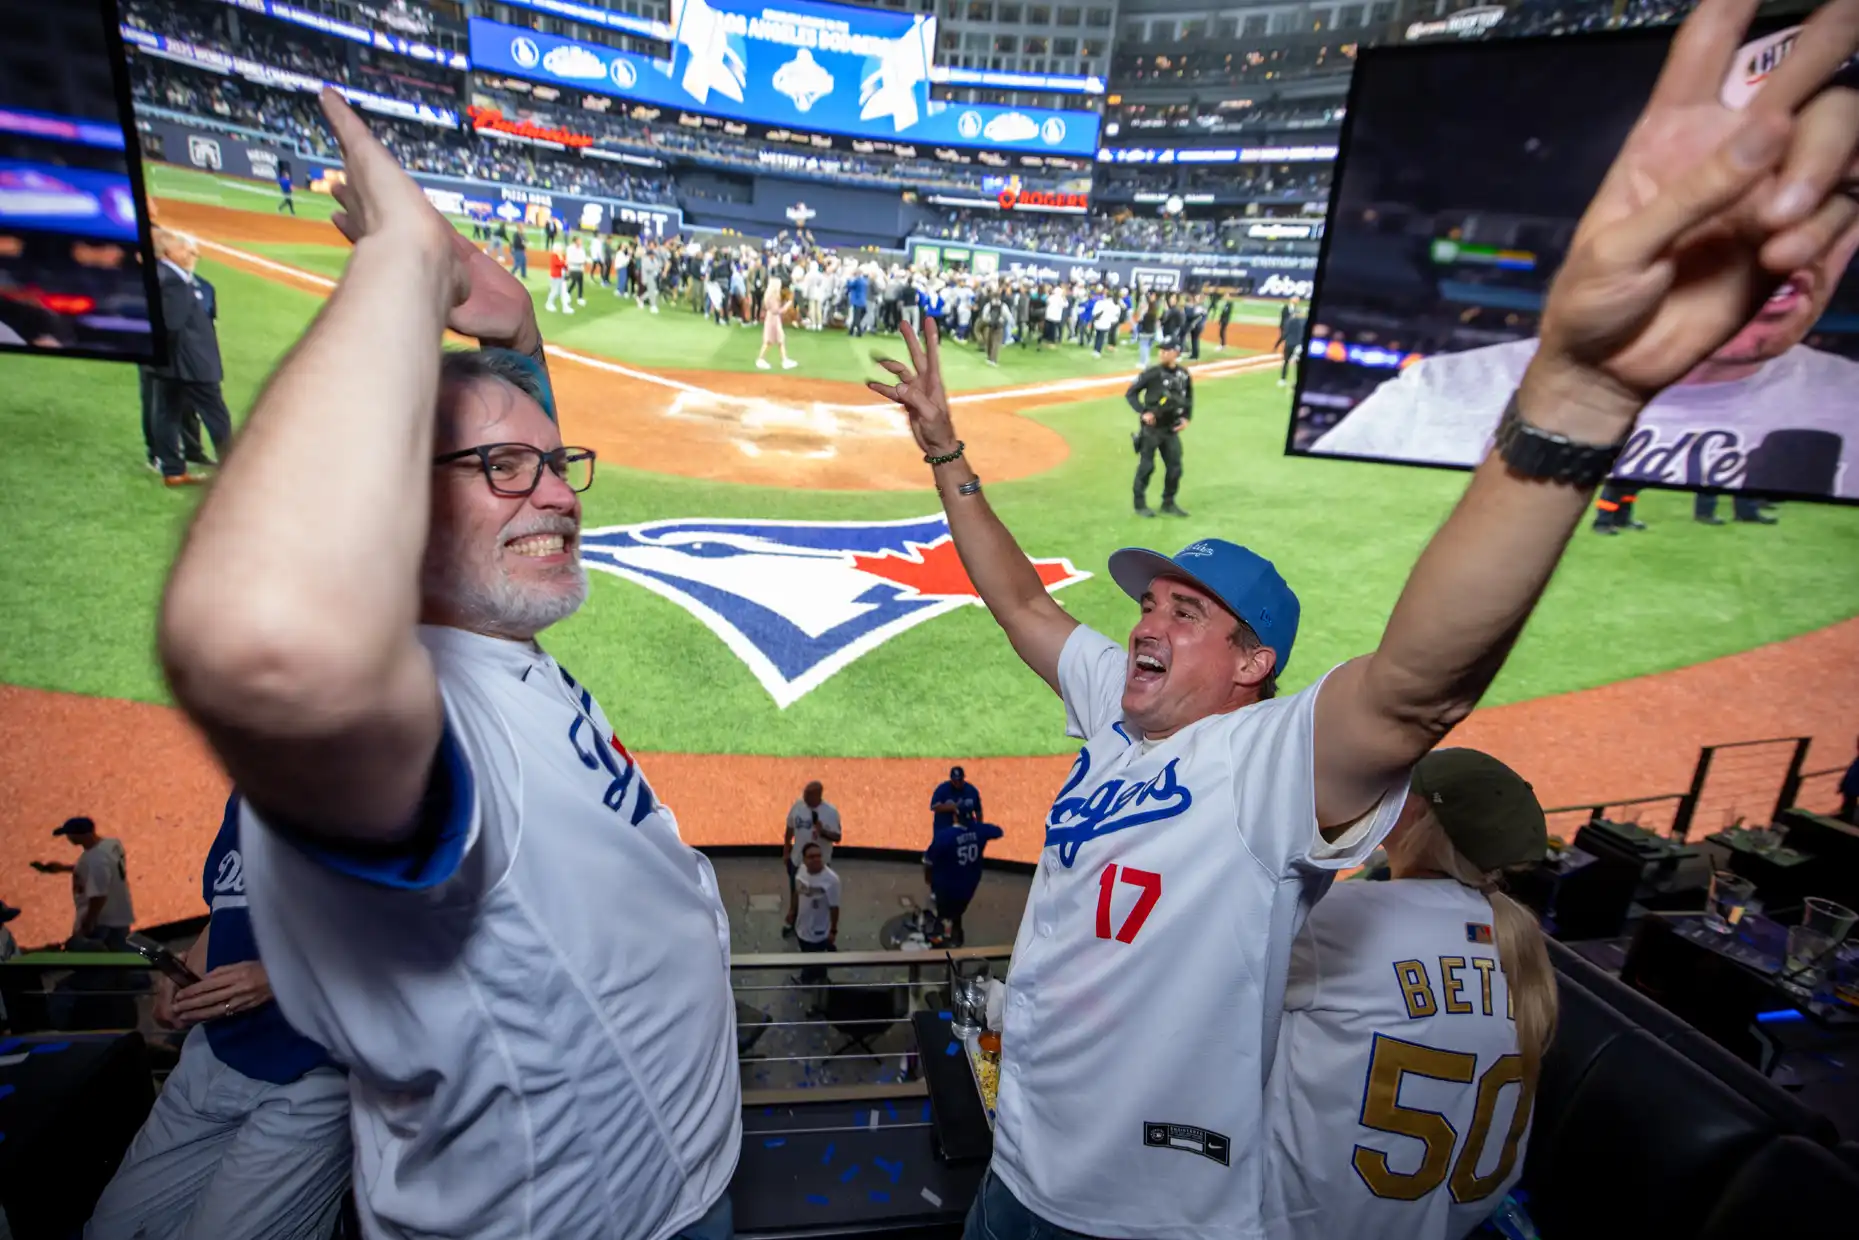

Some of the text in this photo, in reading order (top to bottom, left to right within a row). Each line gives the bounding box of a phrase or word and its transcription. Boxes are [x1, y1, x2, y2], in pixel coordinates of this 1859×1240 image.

[1019, 190, 1089, 208] ROGERS
[956, 843, 979, 866] 50
[1096, 863, 1162, 945] 17
[1351, 1030, 1534, 1204] 50
